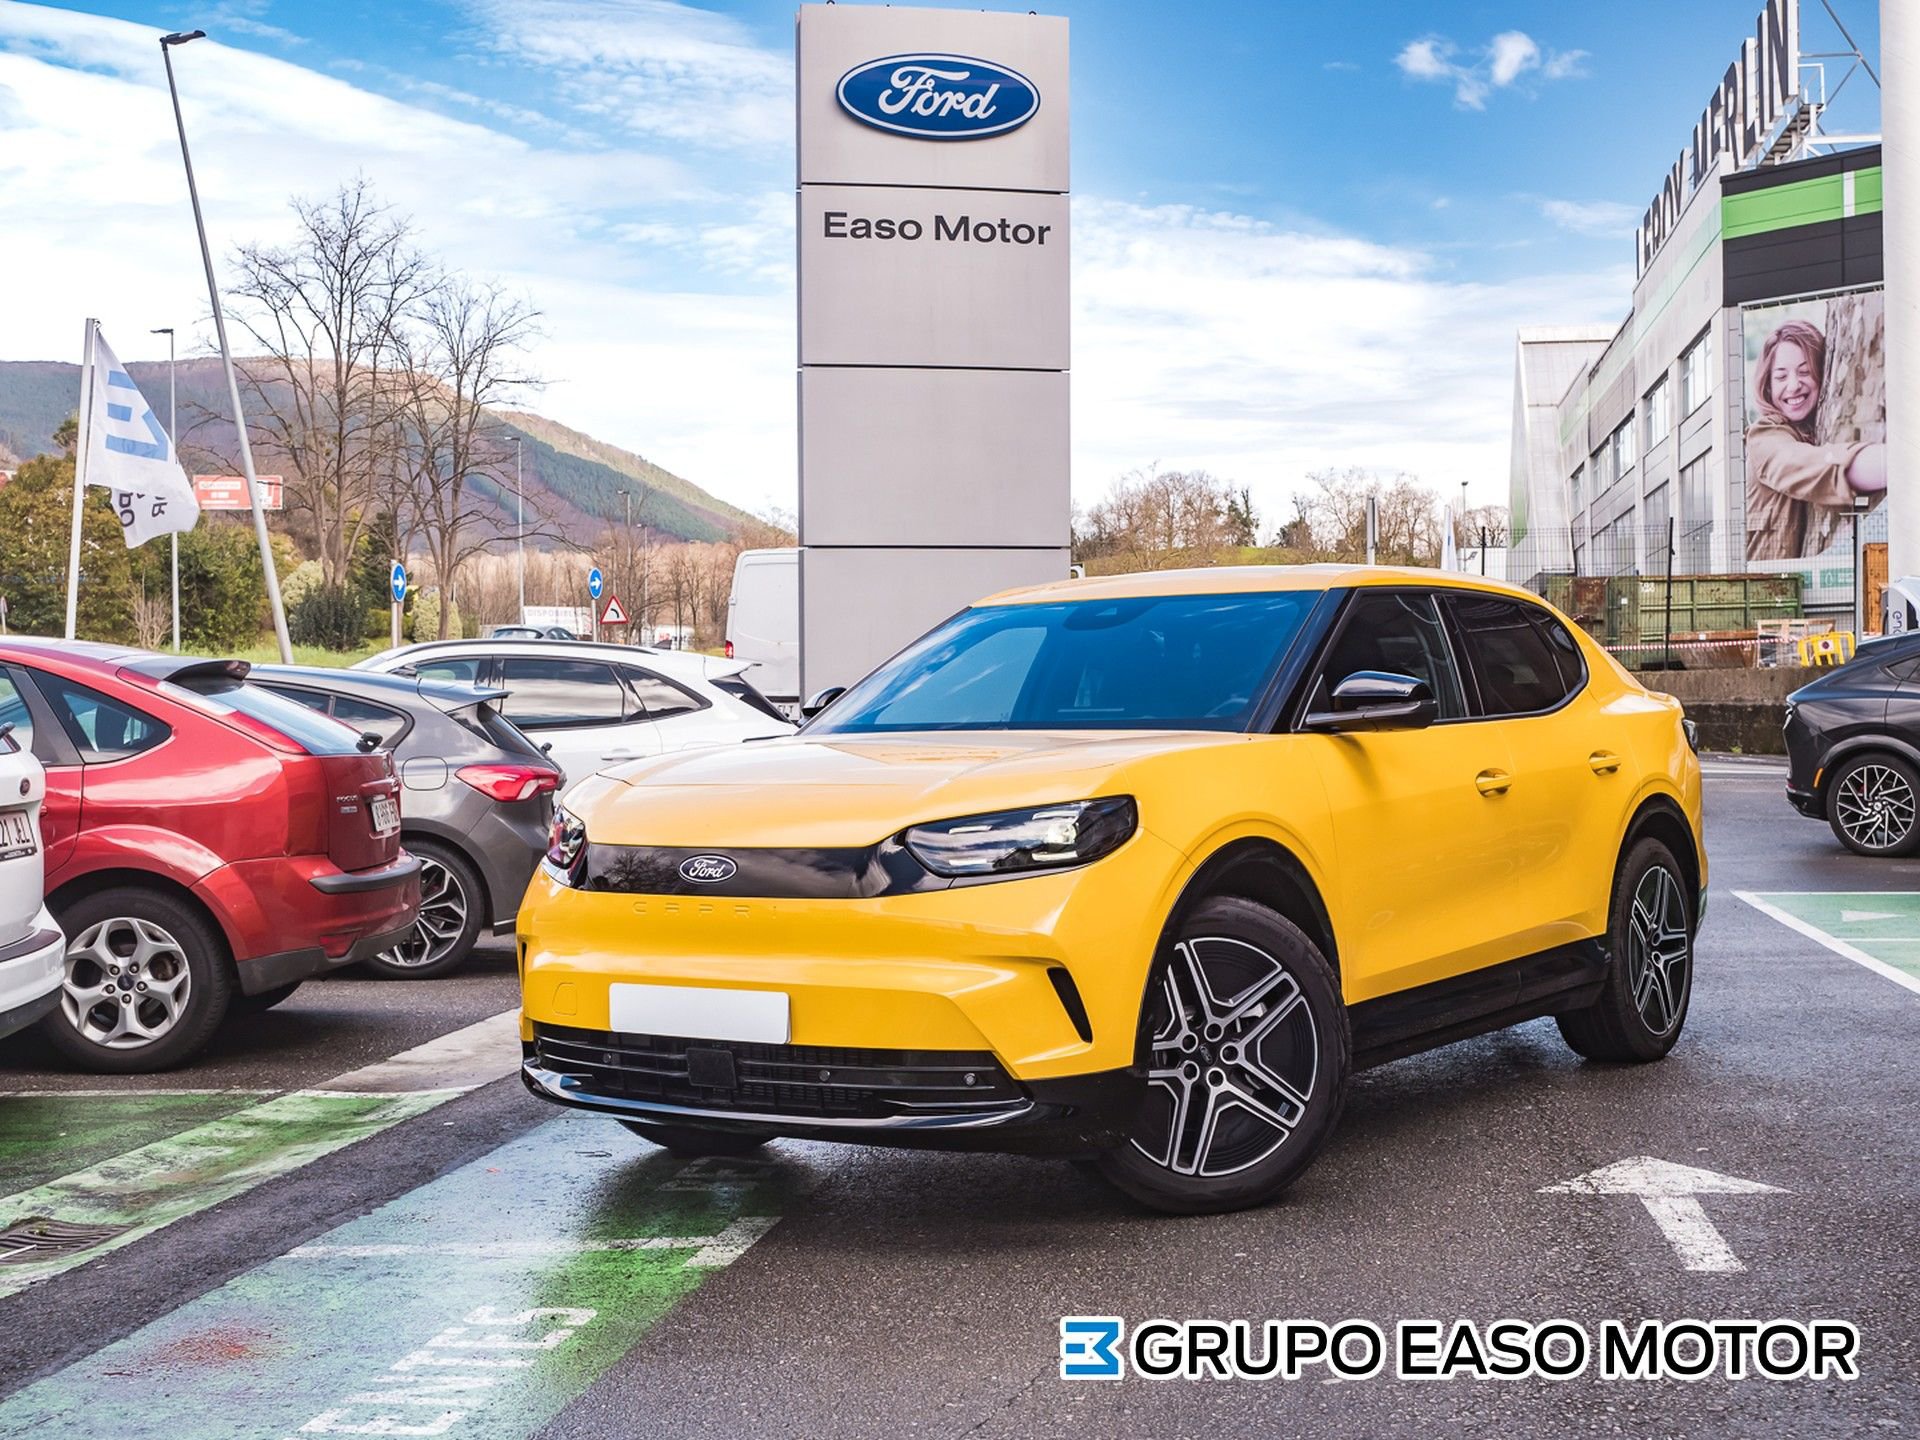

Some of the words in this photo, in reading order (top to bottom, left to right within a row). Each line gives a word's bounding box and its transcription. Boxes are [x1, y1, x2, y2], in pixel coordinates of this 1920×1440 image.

[878, 66, 1000, 119] Ford
[1692, 0, 1799, 190] MERLIN
[824, 212, 923, 241] Easo
[934, 215, 1051, 245] Motor
[689, 858, 726, 878] Ford
[632, 901, 777, 919] CAPRI
